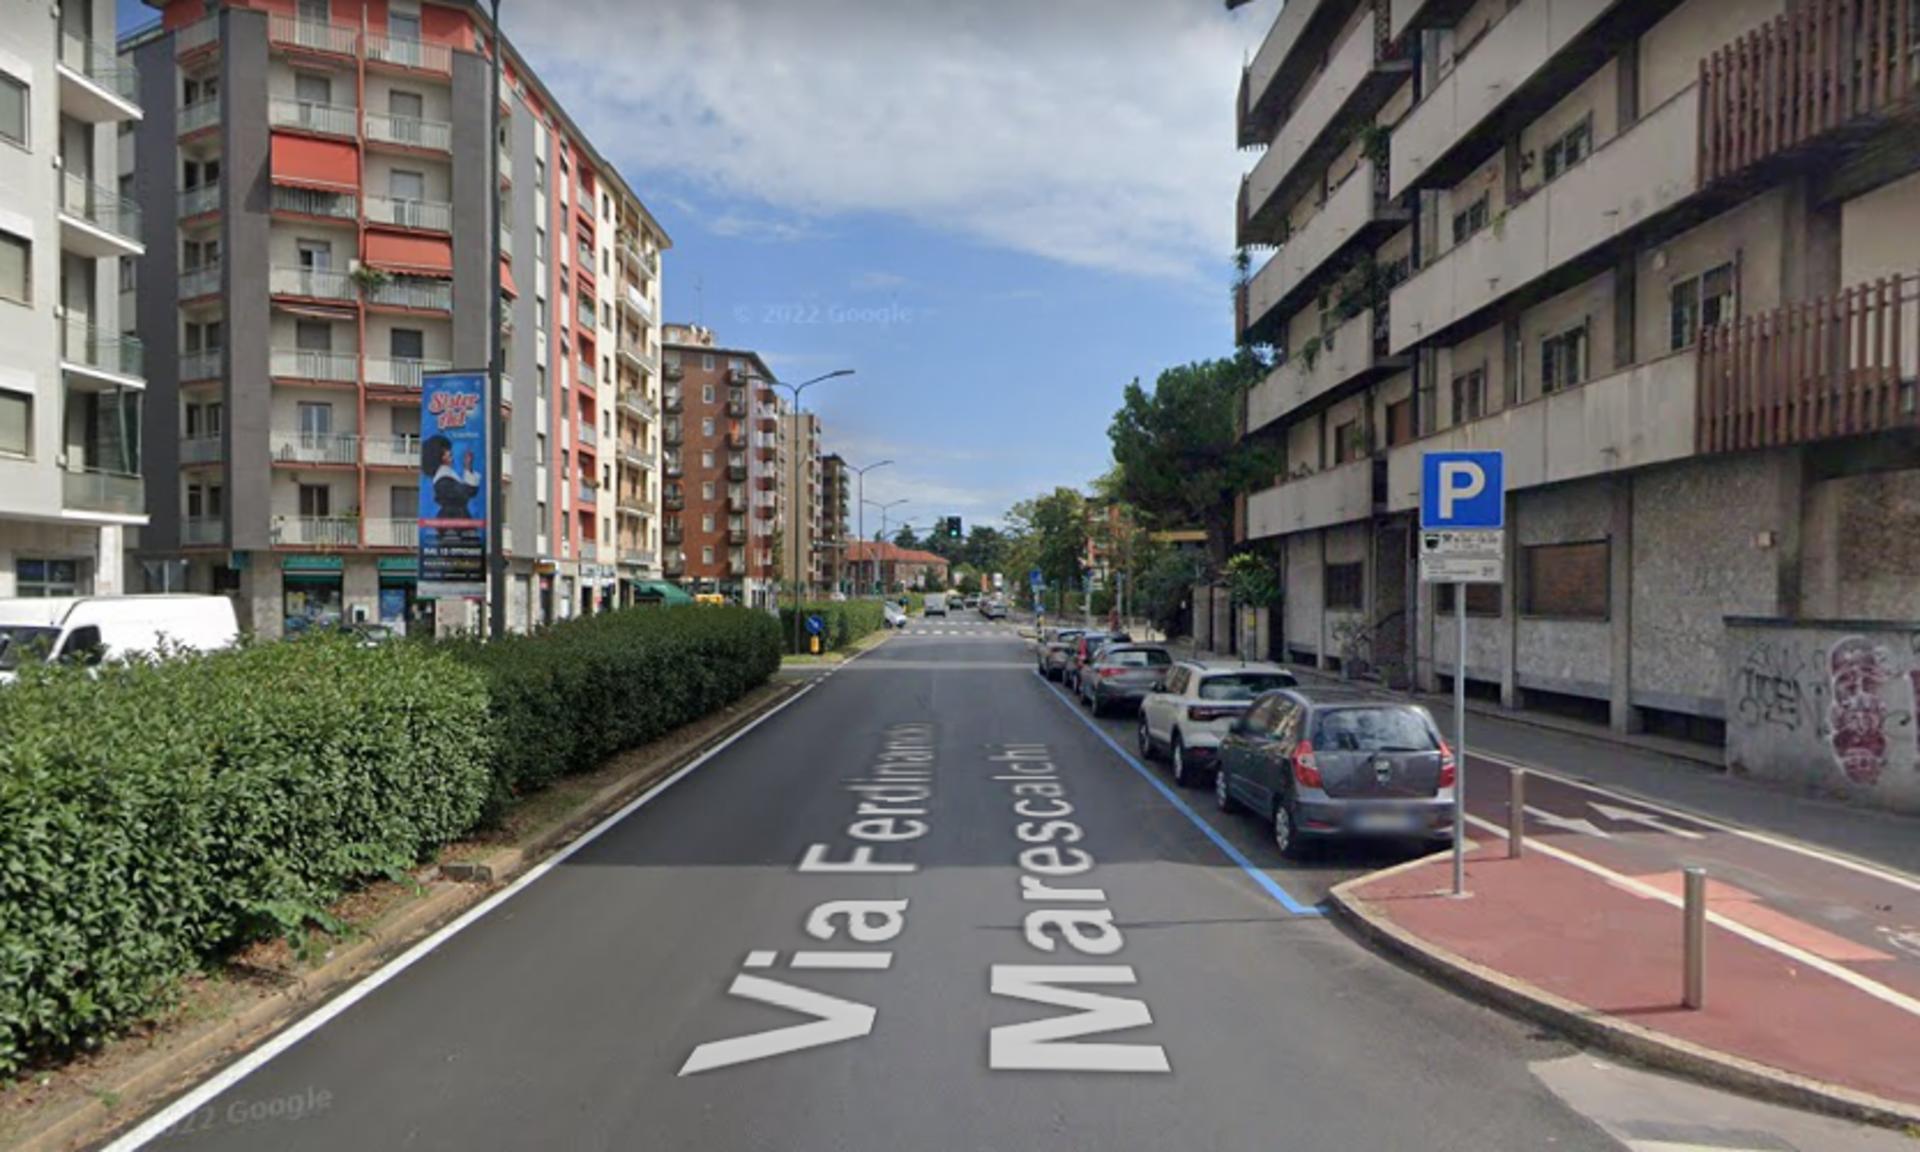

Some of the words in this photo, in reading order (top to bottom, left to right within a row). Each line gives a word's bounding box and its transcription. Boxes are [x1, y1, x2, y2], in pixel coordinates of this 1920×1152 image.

[429, 391, 480, 413] Sister
[438, 411, 466, 429] Act
[1438, 460, 1486, 520] P
